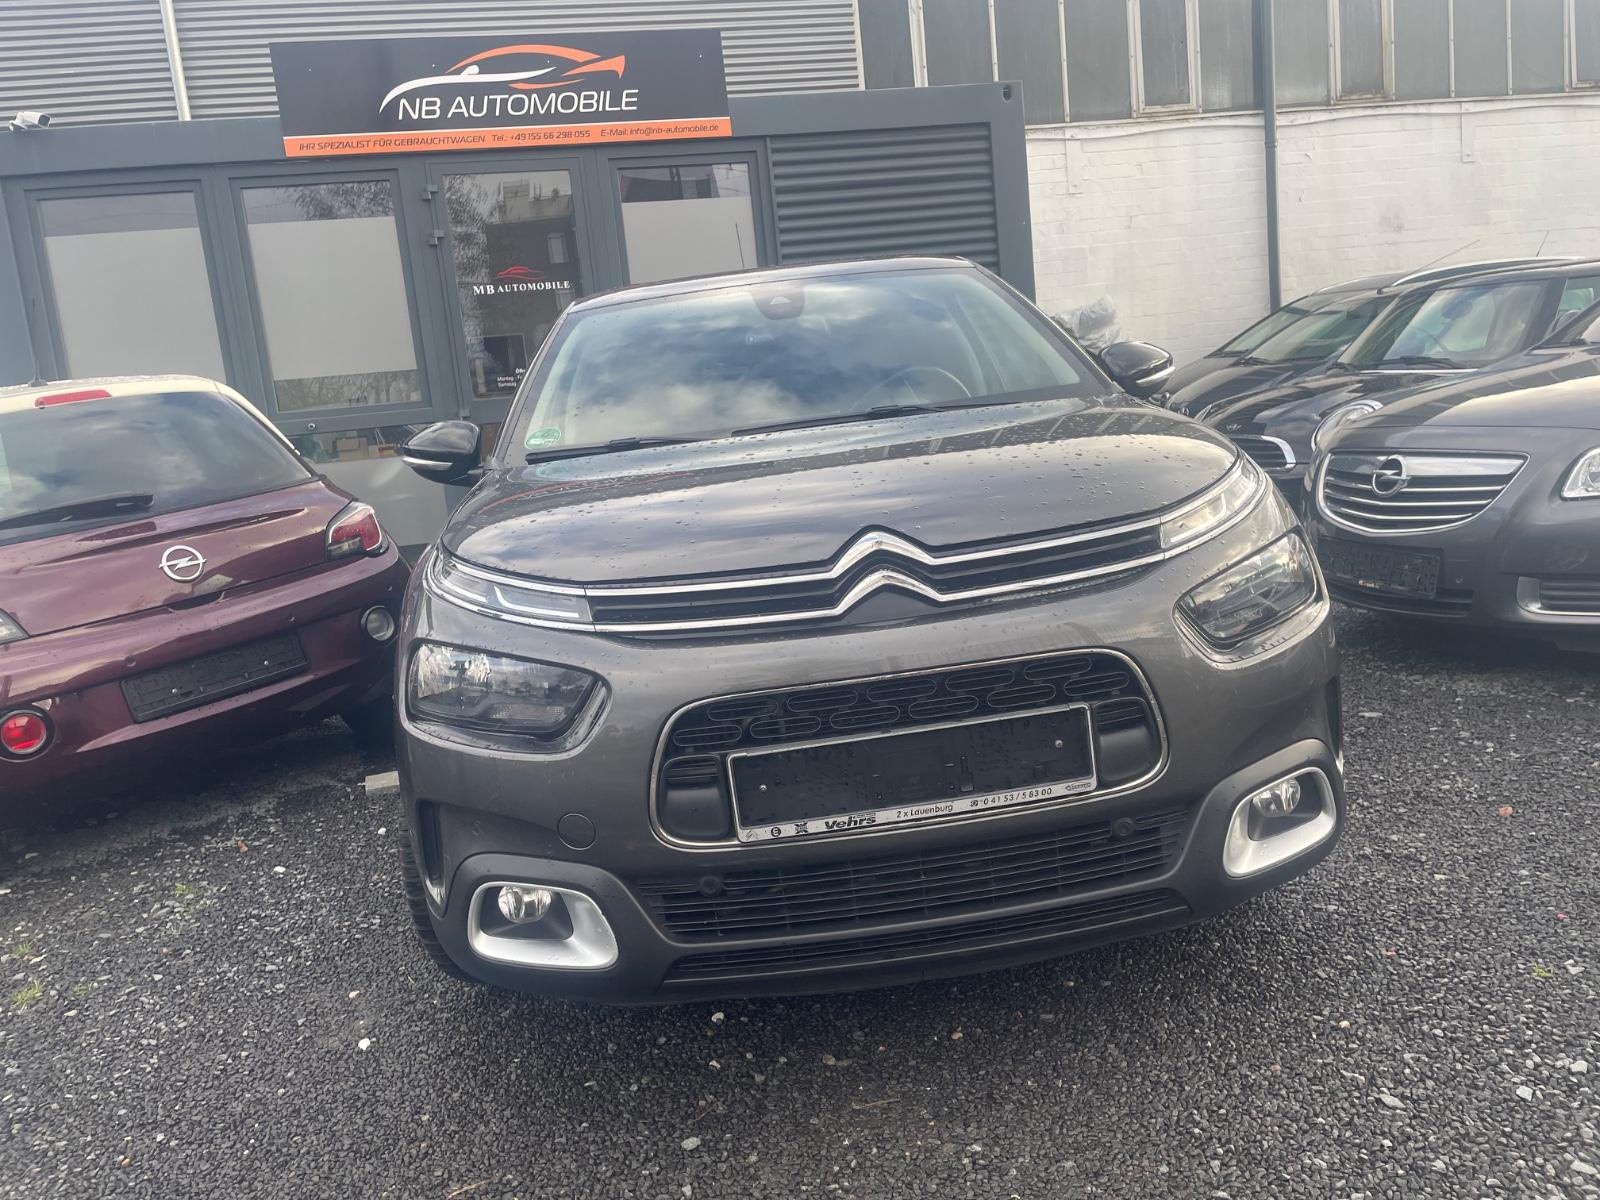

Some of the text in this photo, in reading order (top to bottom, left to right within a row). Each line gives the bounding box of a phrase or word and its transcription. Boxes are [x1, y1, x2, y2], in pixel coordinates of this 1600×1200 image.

[398, 89, 639, 121] NB AUTOMOBILE
[543, 131, 554, 140] 66
[556, 131, 573, 139] 298
[574, 130, 591, 138] 055
[601, 125, 719, 137] E-Mail: info@nb-automobile.de
[299, 135, 486, 151] IHR SPEZIALIST FÜR GEBRAUCHTWAGEN
[473, 280, 571, 296] MB AUTOMOBILE
[824, 815, 877, 830] Vehrs
[896, 810, 902, 818] 2
[910, 804, 953, 816] Lauenburg
